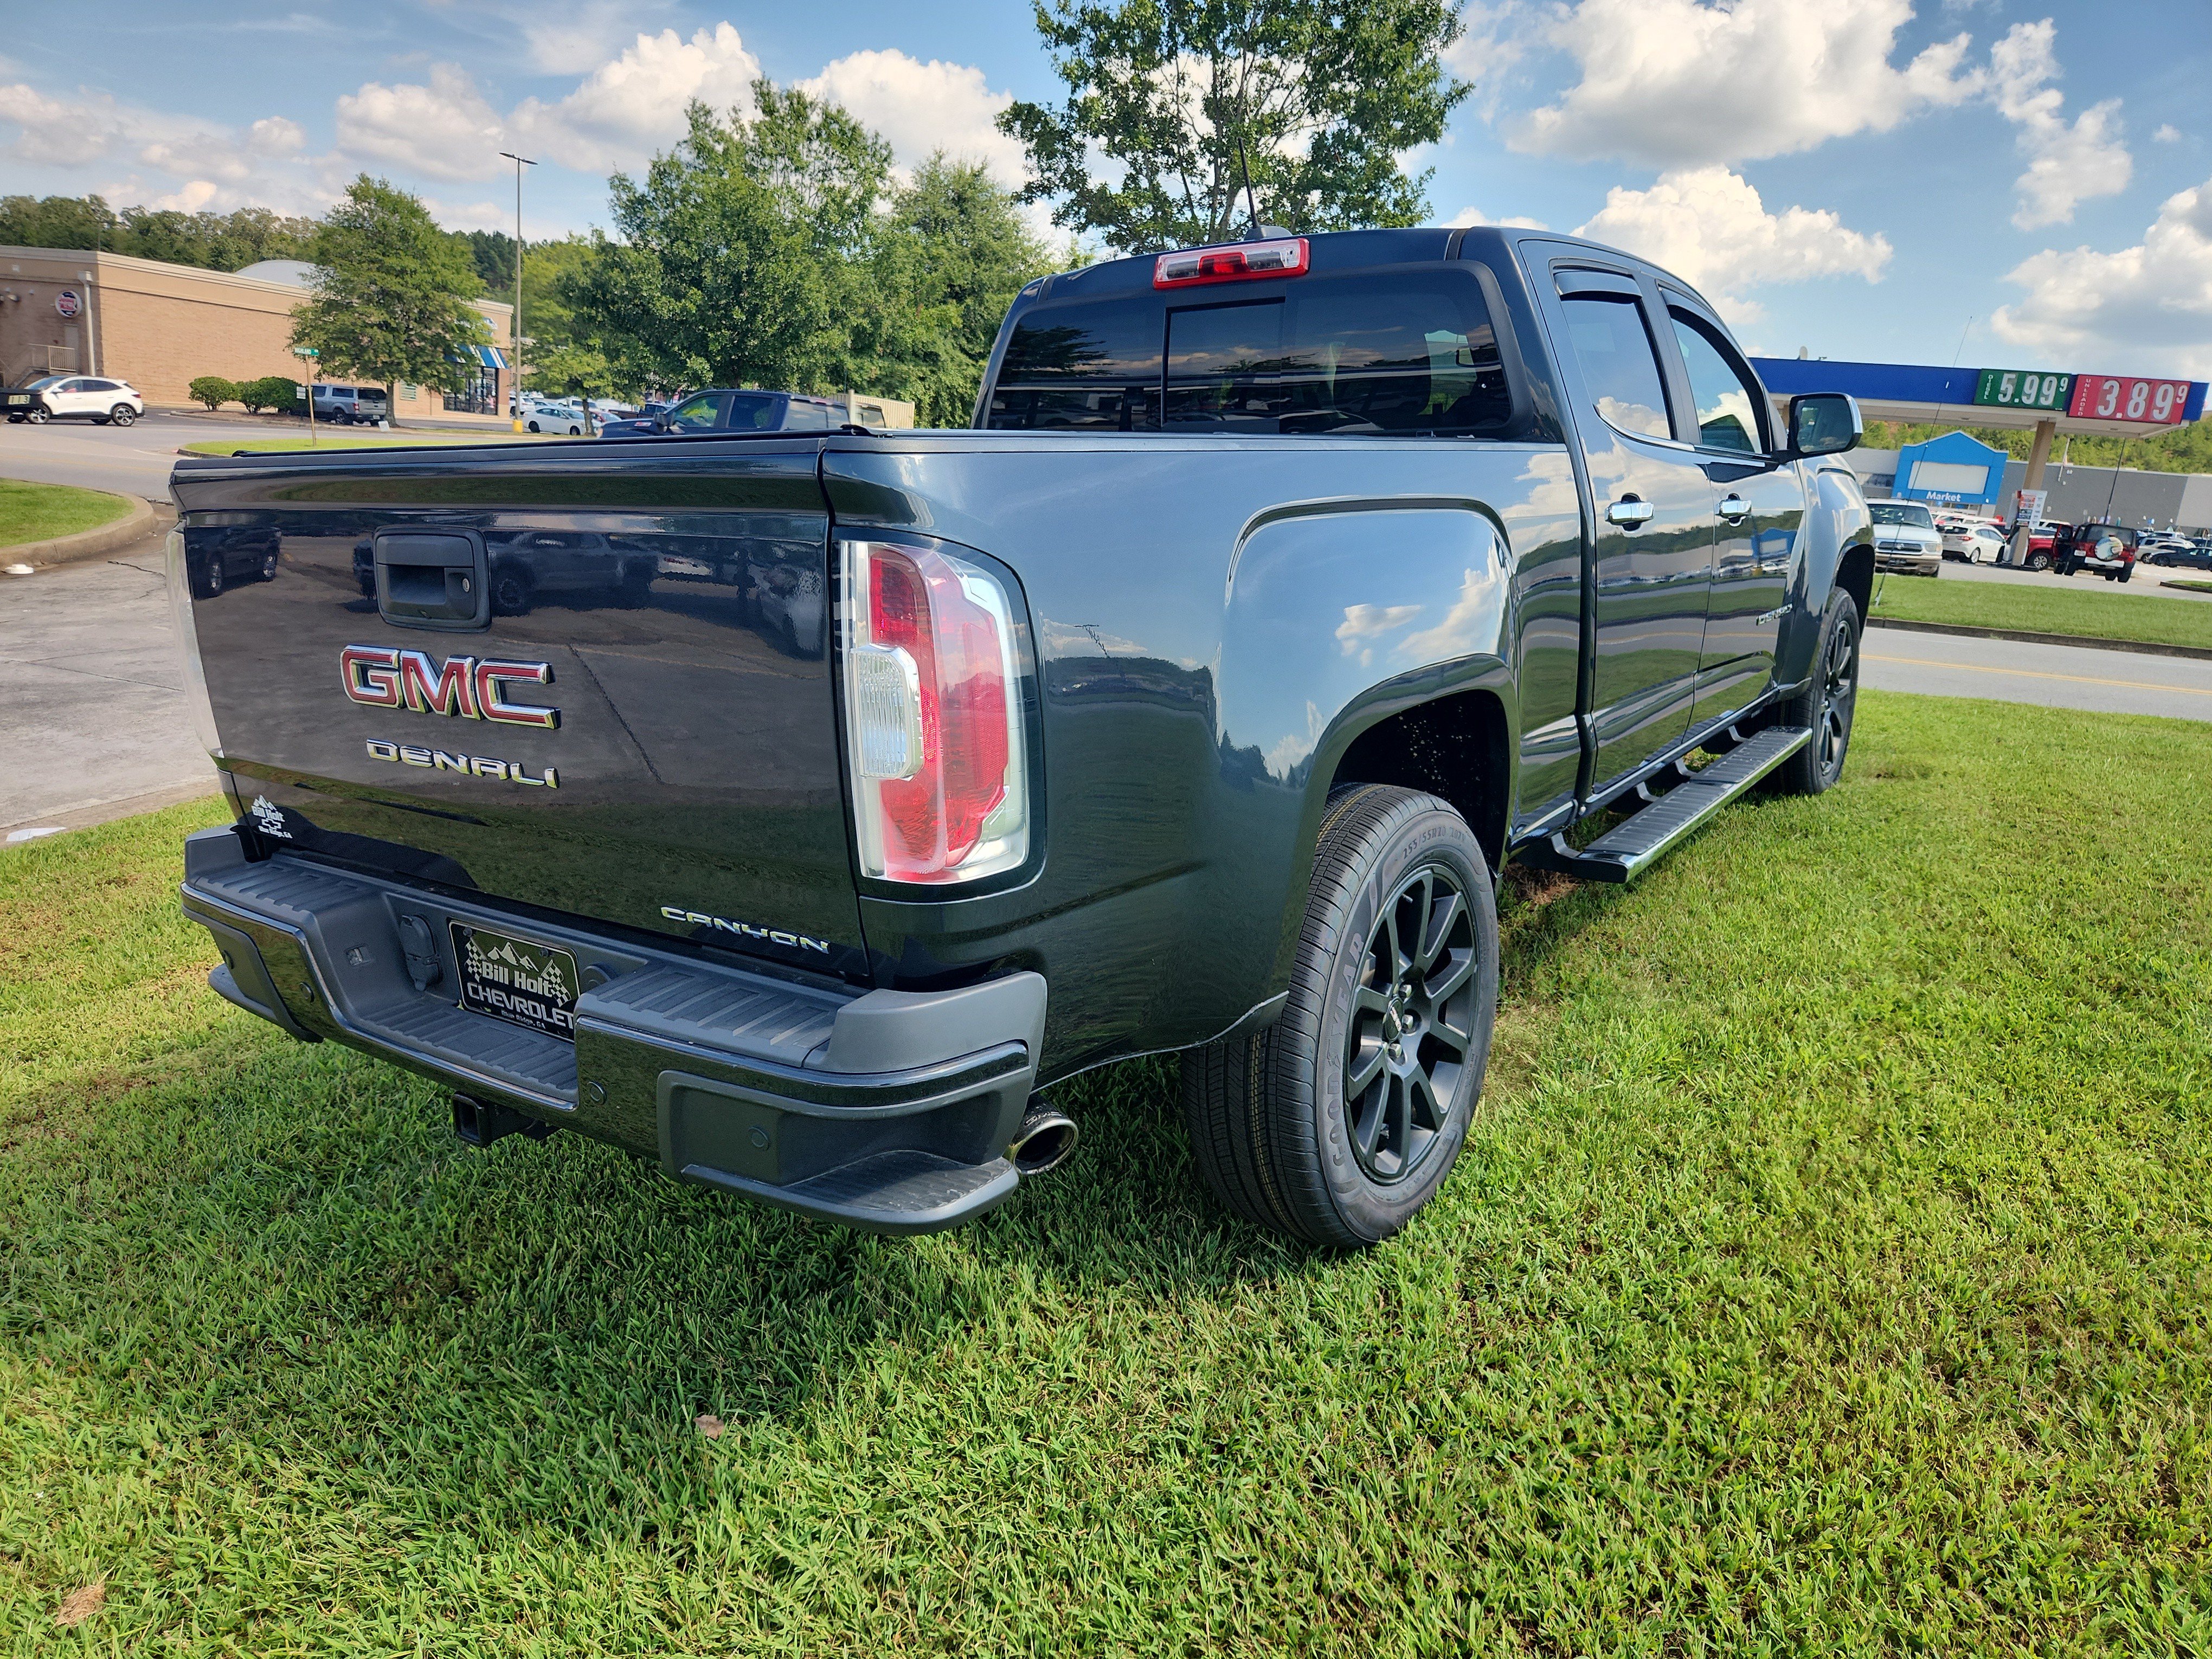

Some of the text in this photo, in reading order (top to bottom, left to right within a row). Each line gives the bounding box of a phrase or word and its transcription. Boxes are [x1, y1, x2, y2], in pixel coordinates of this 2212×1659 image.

[2078, 378, 2091, 416] UNLEADED
[1926, 491, 1961, 502] Market
[340, 645, 561, 729] GMC
[366, 738, 558, 789] DENALI
[661, 906, 829, 954] CANYON
[482, 961, 552, 997] Bill Holt
[467, 982, 574, 1030] CHEVROLET
[501, 1009, 515, 1018] Blue
